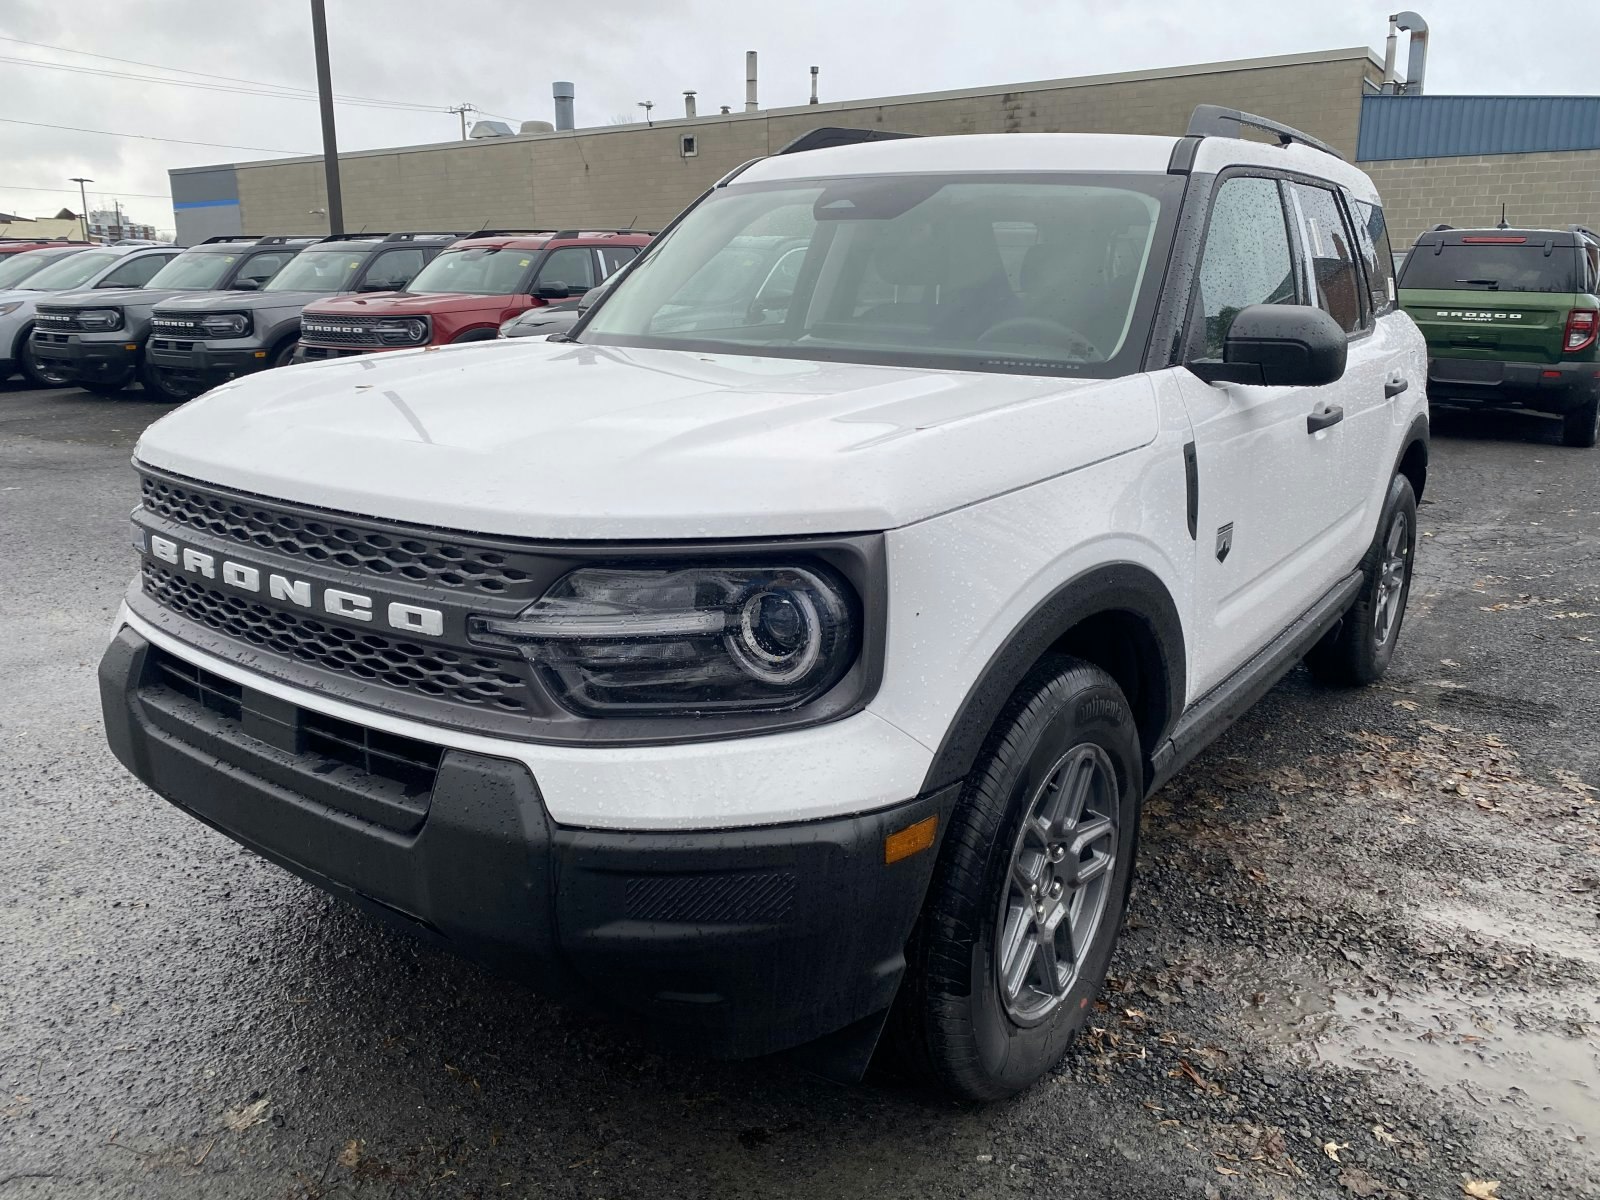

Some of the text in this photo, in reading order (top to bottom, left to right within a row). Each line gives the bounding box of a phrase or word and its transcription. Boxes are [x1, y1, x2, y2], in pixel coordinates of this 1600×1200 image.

[1436, 311, 1522, 319] BRONCO
[306, 325, 363, 333] BRONCO
[151, 535, 444, 636] BRONCO
[1076, 695, 1126, 728] ontinental
